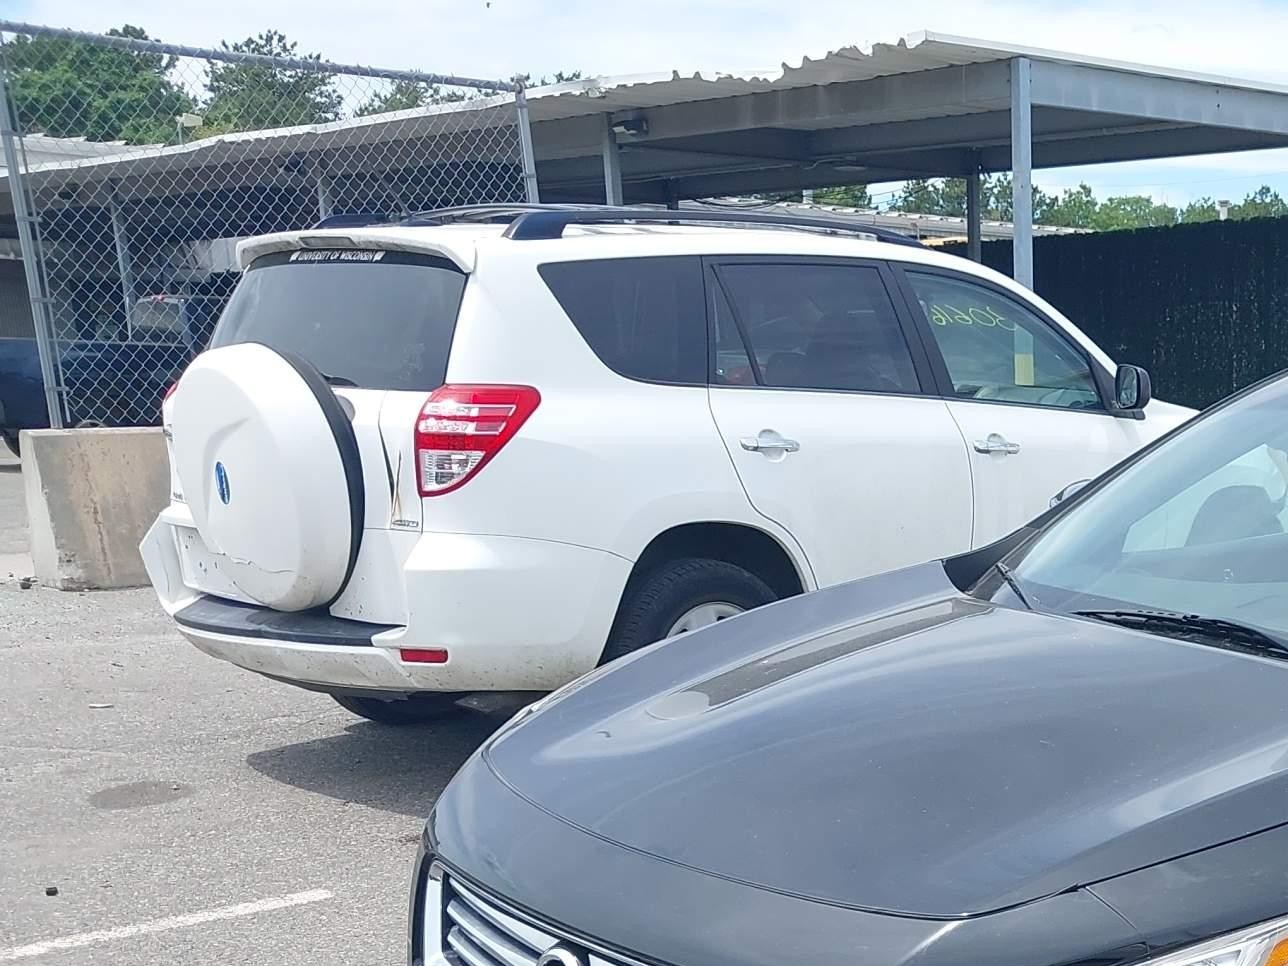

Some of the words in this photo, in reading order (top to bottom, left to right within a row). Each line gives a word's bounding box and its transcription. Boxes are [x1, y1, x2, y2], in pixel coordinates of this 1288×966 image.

[298, 250, 331, 261] UNIVERSITY
[330, 251, 342, 260] OF
[340, 250, 376, 261] WISCONSIN
